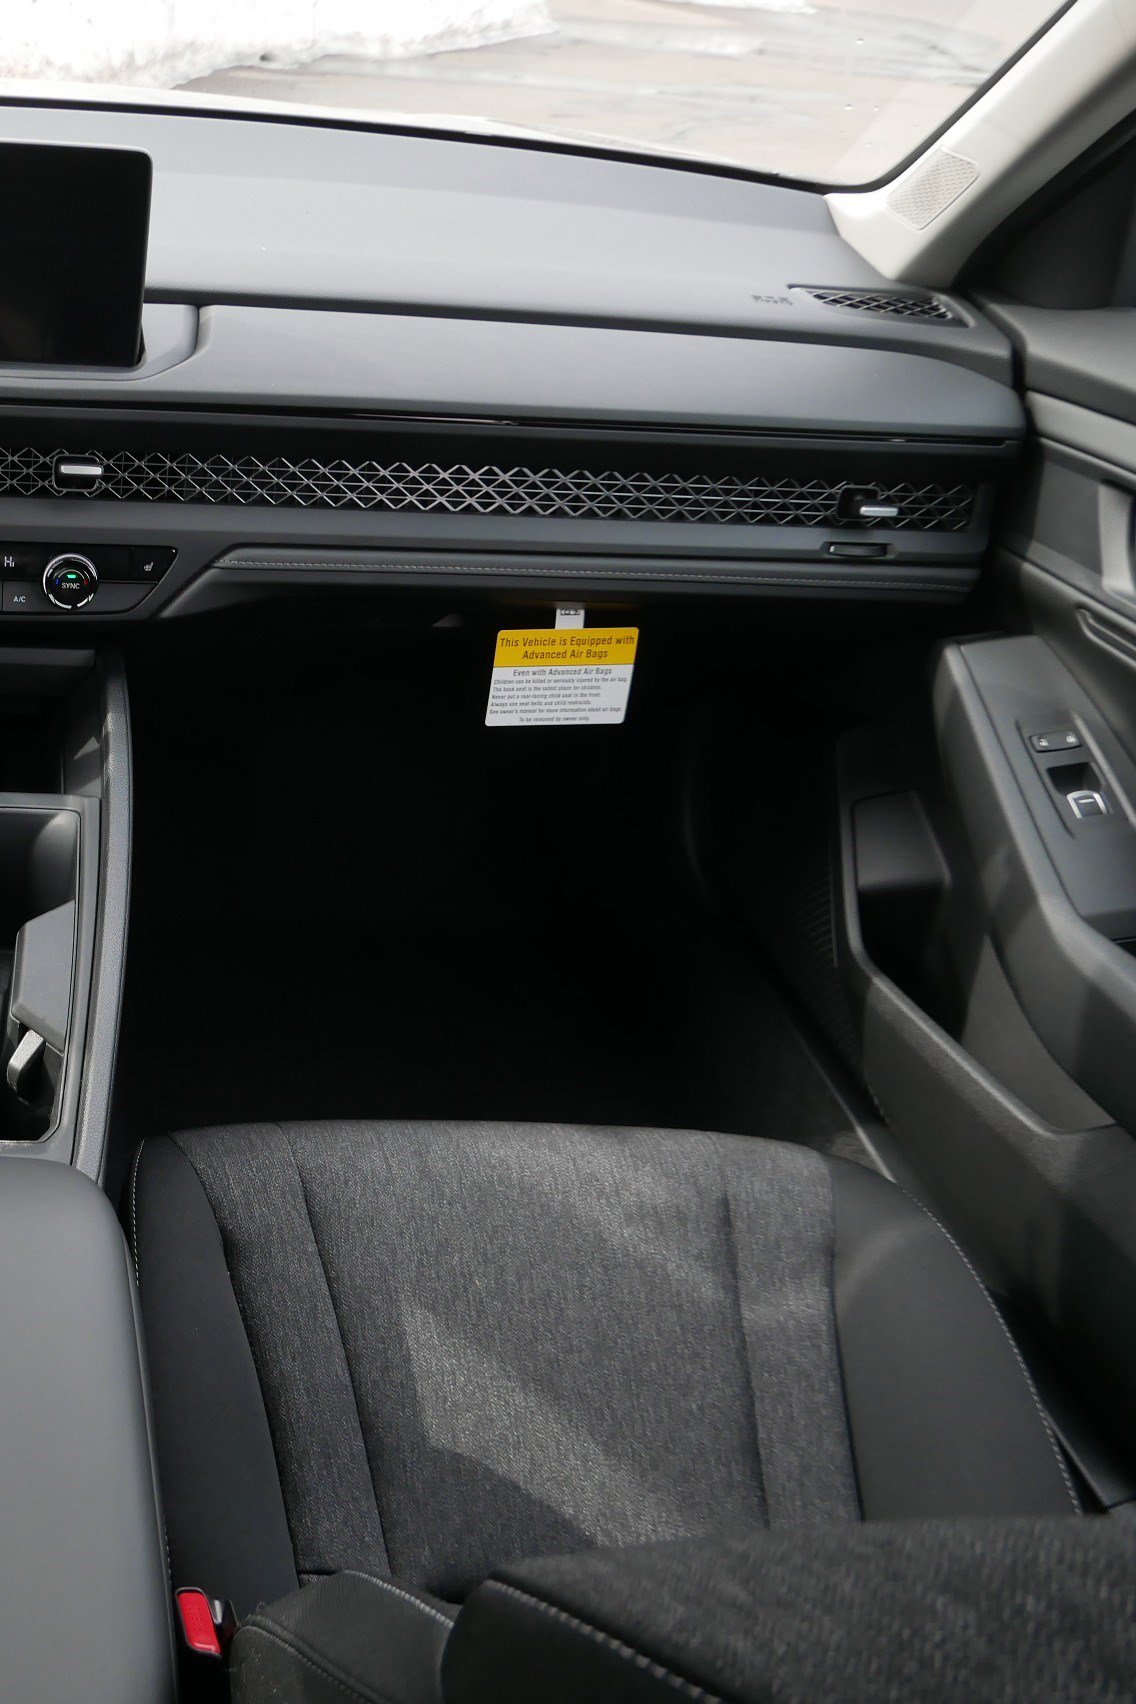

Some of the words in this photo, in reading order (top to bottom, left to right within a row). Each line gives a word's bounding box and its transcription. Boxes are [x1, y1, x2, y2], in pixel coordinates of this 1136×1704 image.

[61, 581, 80, 590] SYNC
[13, 594, 26, 603] A/C
[500, 637, 519, 648] This
[522, 636, 557, 647] Vehicle
[559, 636, 567, 646] is
[570, 635, 613, 647] Equipped
[615, 635, 635, 645] with
[522, 650, 567, 660] Advanced
[569, 649, 584, 659] Air
[586, 649, 609, 660] Bags
[513, 669, 530, 677] Even
[548, 668, 582, 676] Advanced
[583, 667, 594, 675] Air
[595, 667, 612, 676] Bags
